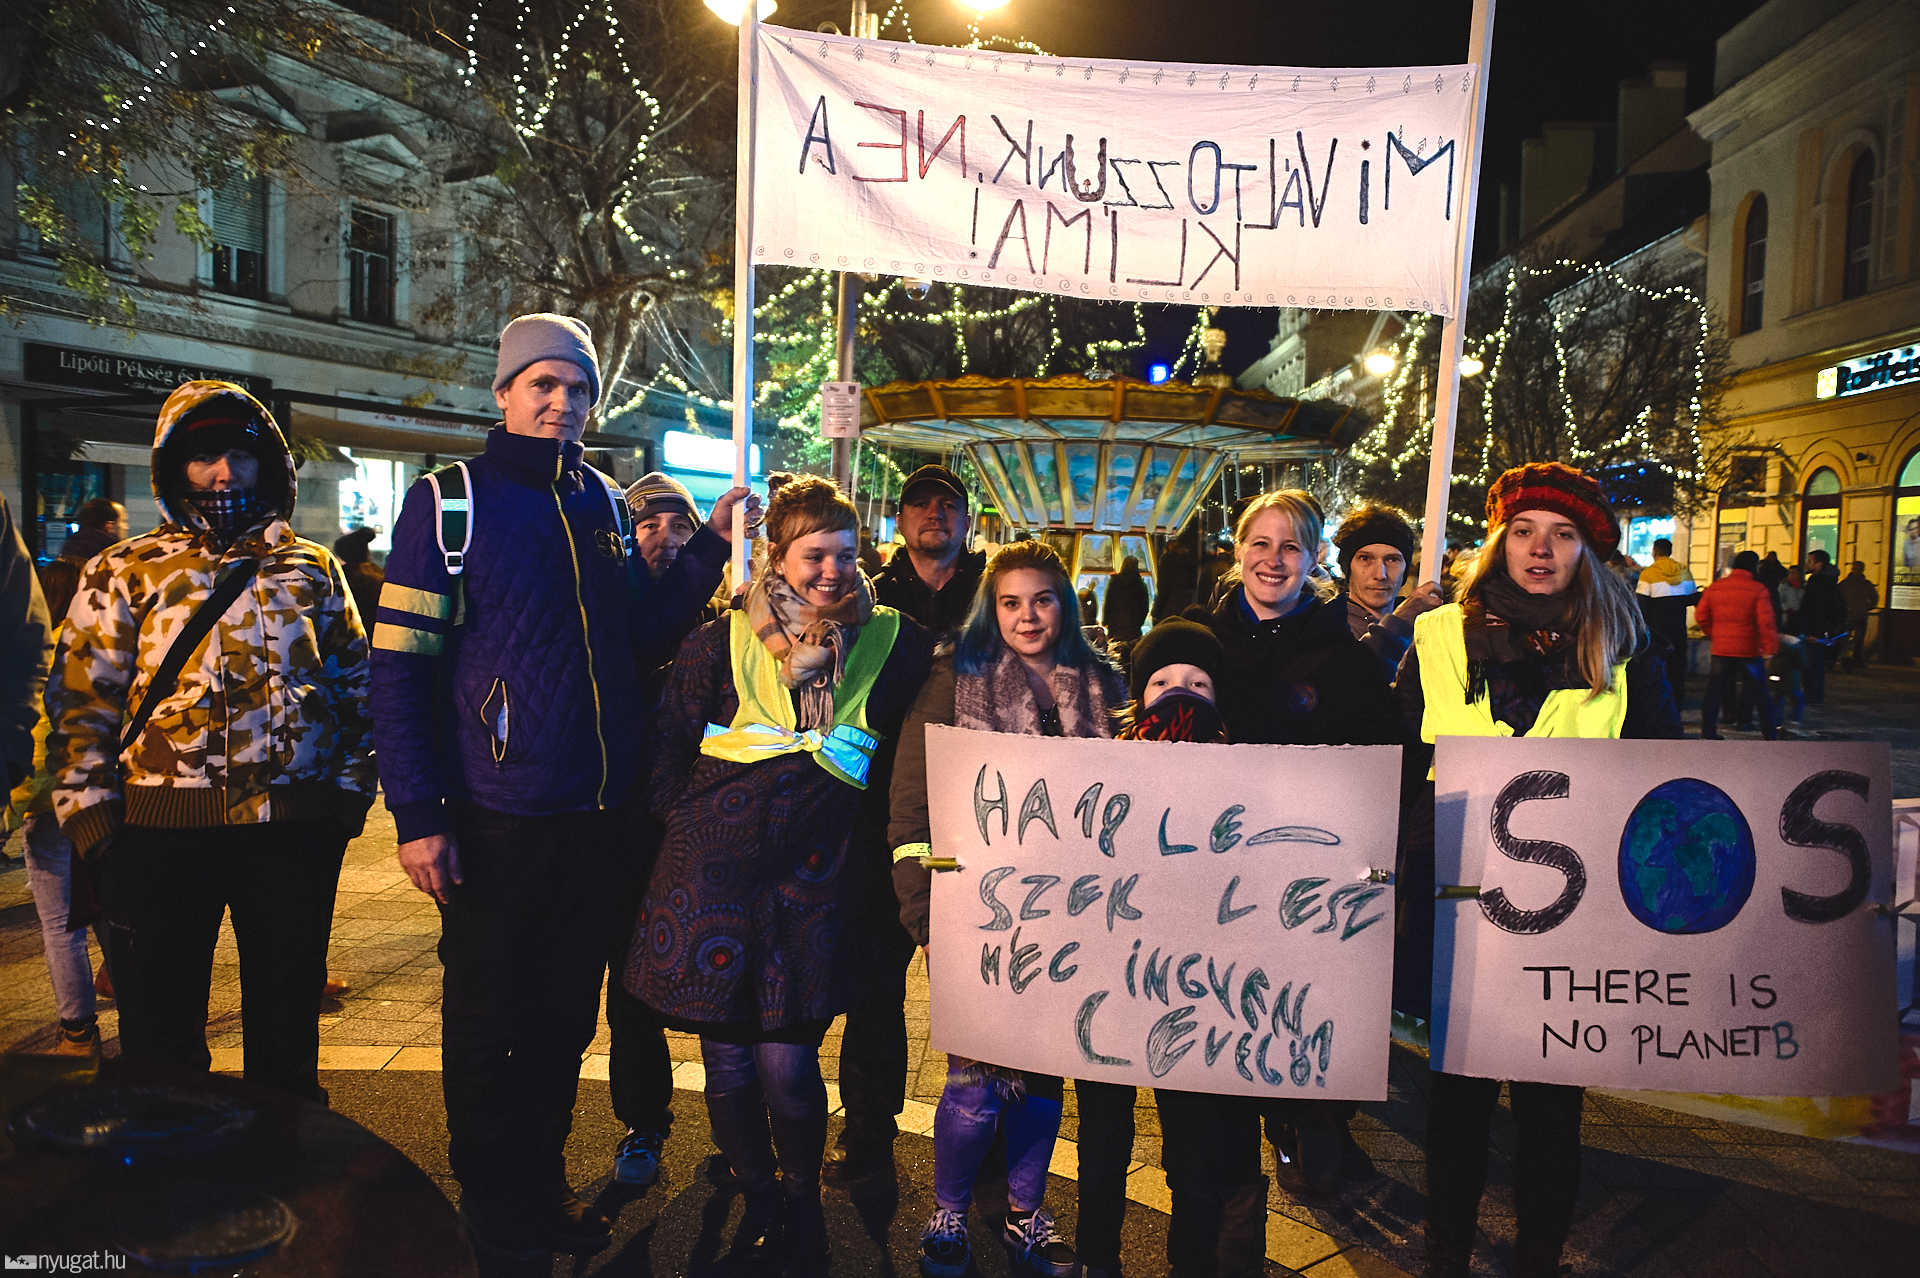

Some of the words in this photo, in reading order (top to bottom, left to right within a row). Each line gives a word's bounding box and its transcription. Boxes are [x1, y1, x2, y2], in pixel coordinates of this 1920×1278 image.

[60, 351, 111, 374] Lipóti
[116, 358, 173, 384] Pékség
[973, 763, 1060, 846] HA
[1073, 781, 1131, 858] 18
[978, 865, 1143, 932] SZEK
[1217, 876, 1386, 942] LESZ
[1522, 966, 1691, 1006] THERE
[1729, 973, 1778, 1010] IS
[1542, 1019, 1607, 1058] NO
